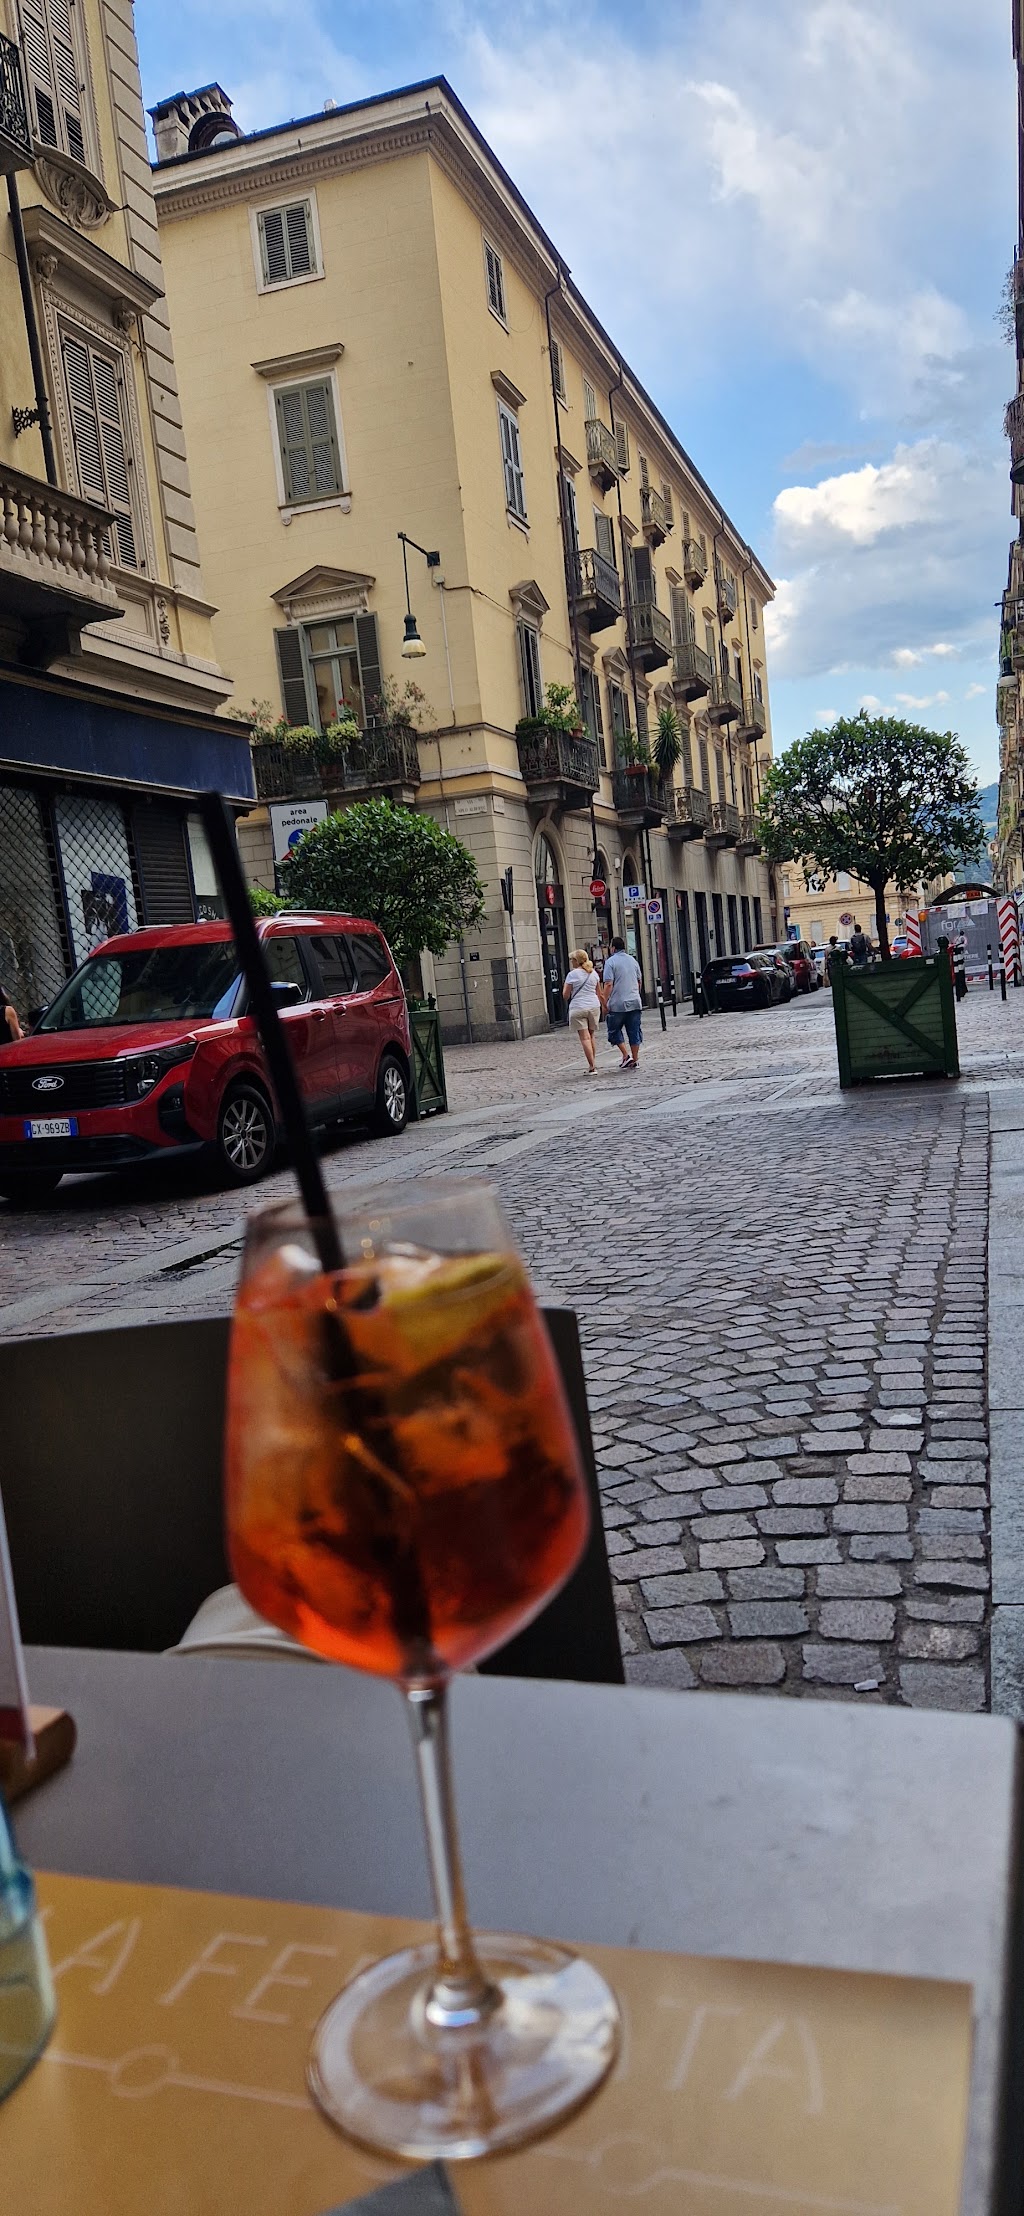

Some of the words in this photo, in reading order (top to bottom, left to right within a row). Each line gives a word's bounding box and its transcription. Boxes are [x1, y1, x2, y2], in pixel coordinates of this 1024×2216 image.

[290, 808, 307, 816] area
[281, 816, 318, 827] pedonale
[630, 887, 637, 896] P
[38, 1078, 58, 1089] Ford
